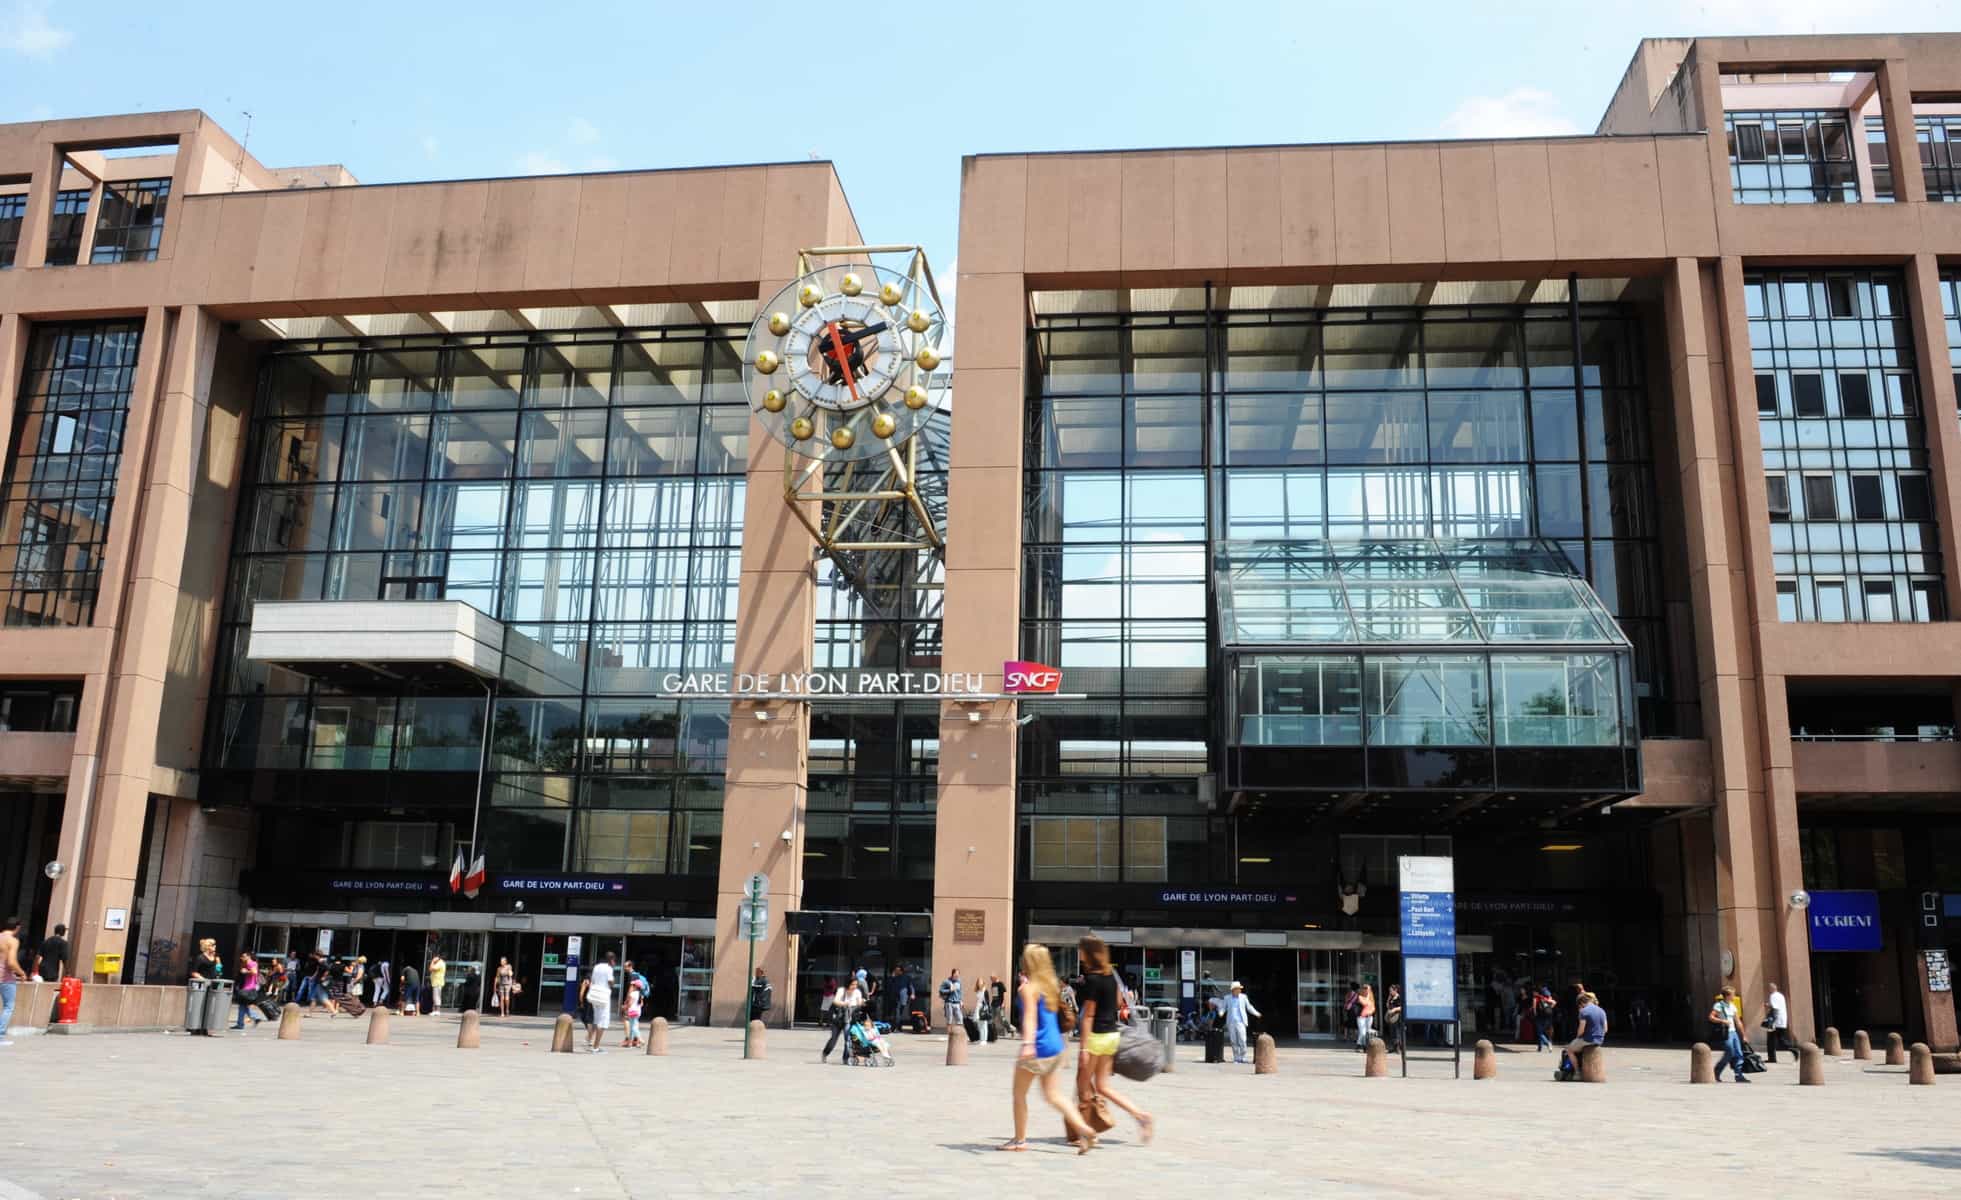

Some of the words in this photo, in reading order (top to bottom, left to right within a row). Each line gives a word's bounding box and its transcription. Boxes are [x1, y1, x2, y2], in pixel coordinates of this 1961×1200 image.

[662, 673, 728, 693] GARE
[738, 673, 769, 693] DE
[780, 673, 847, 693] LYON
[859, 673, 983, 693] PART-DIEU
[1005, 671, 1058, 689] SNCF
[333, 880, 352, 888] GARE
[354, 880, 363, 888] DE
[365, 880, 385, 889] LYON
[503, 880, 525, 888] GARE
[527, 880, 538, 888] DE
[540, 880, 561, 889] LYON
[563, 881, 605, 890] PART-DIEU
[1162, 893, 1186, 902] GARE
[1189, 893, 1200, 902] DE
[1204, 893, 1228, 902] LYON
[1815, 915, 1871, 927] L'ORIENT
